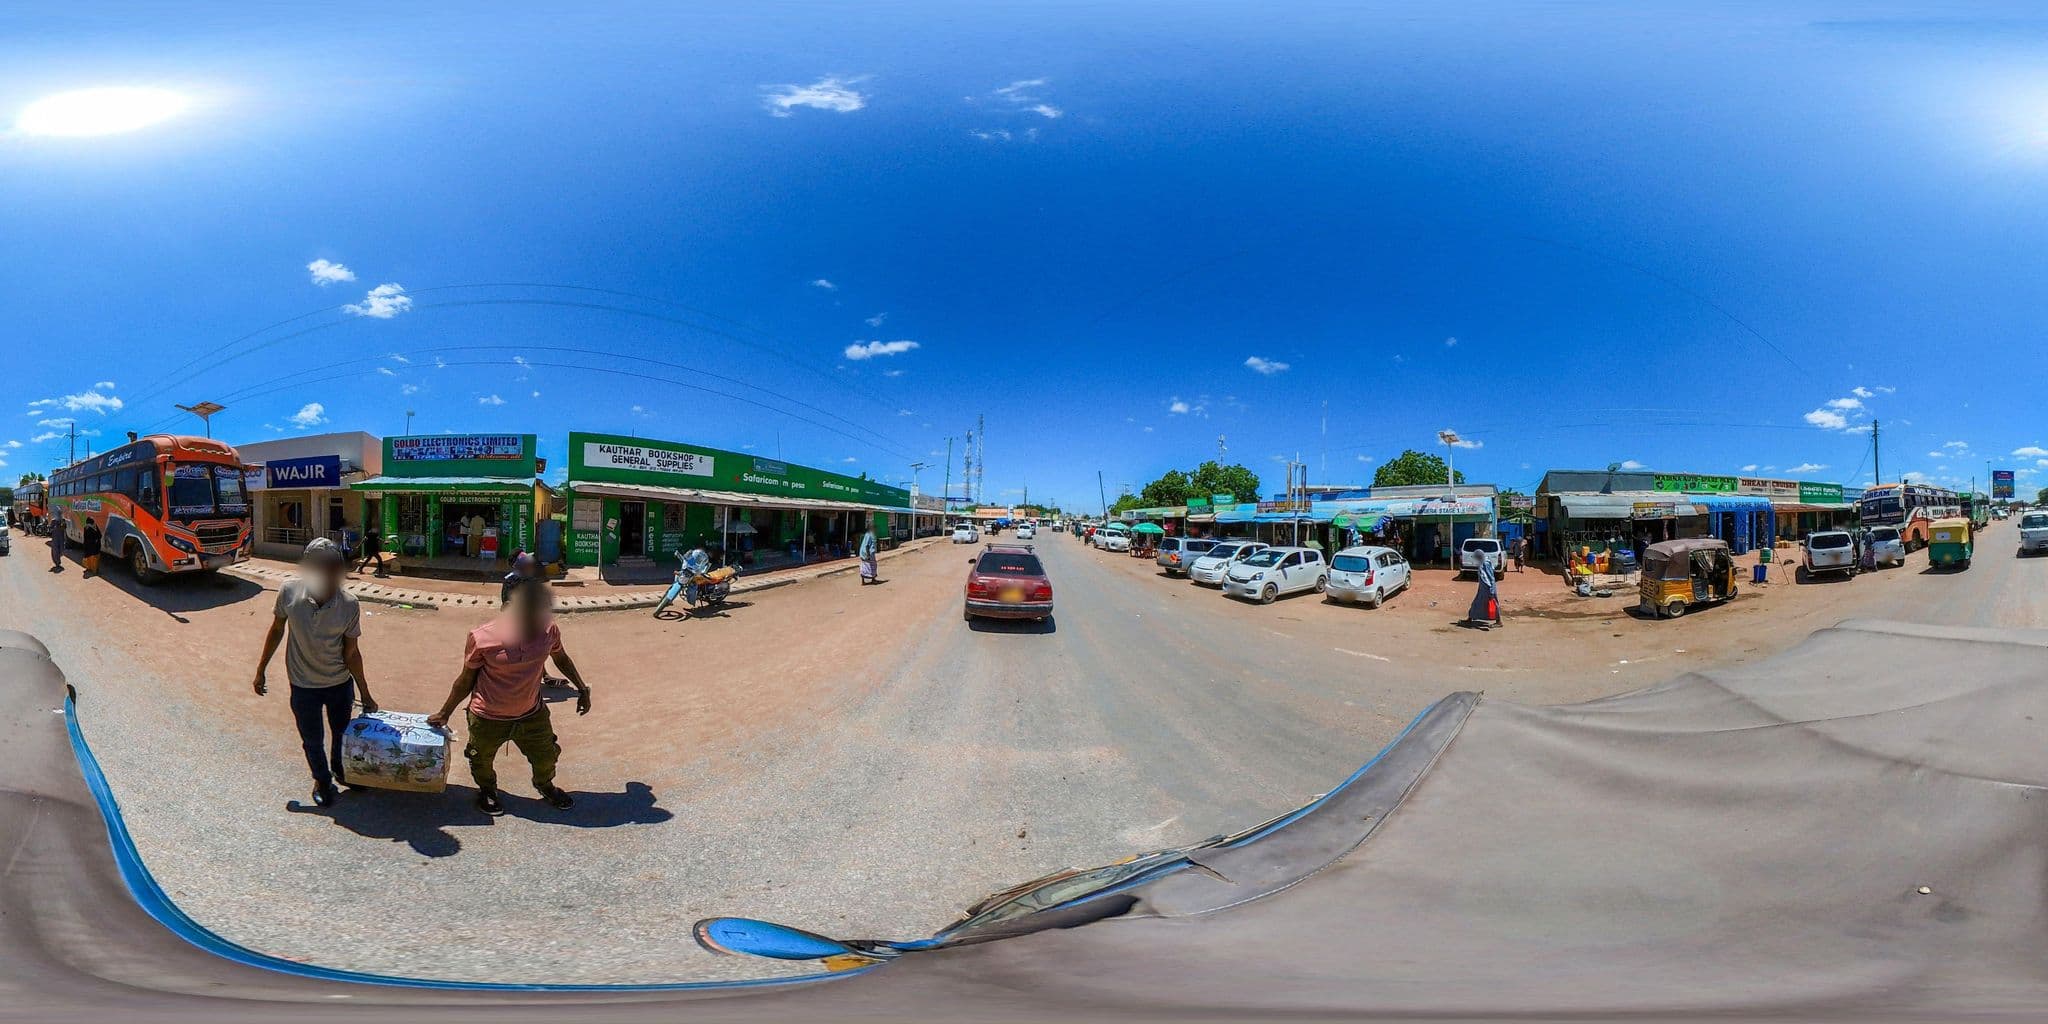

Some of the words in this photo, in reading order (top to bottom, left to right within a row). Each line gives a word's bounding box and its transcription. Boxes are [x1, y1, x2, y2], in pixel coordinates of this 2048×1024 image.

[422, 437, 480, 448] ELECTRONICS
[481, 436, 518, 446] LIMITED
[599, 444, 642, 457] KAUTHAR
[648, 450, 694, 461] BOOKSHOP
[611, 454, 651, 466] GENERAL
[656, 459, 694, 470] SUPPLIES
[275, 464, 325, 481] WAJIR
[742, 472, 779, 486] Safaricom
[782, 480, 789, 488] m
[791, 481, 806, 490] pesa
[822, 480, 844, 491] Safaricom
[1742, 479, 1767, 487] DREAM
[1772, 480, 1797, 488] CRUISER
